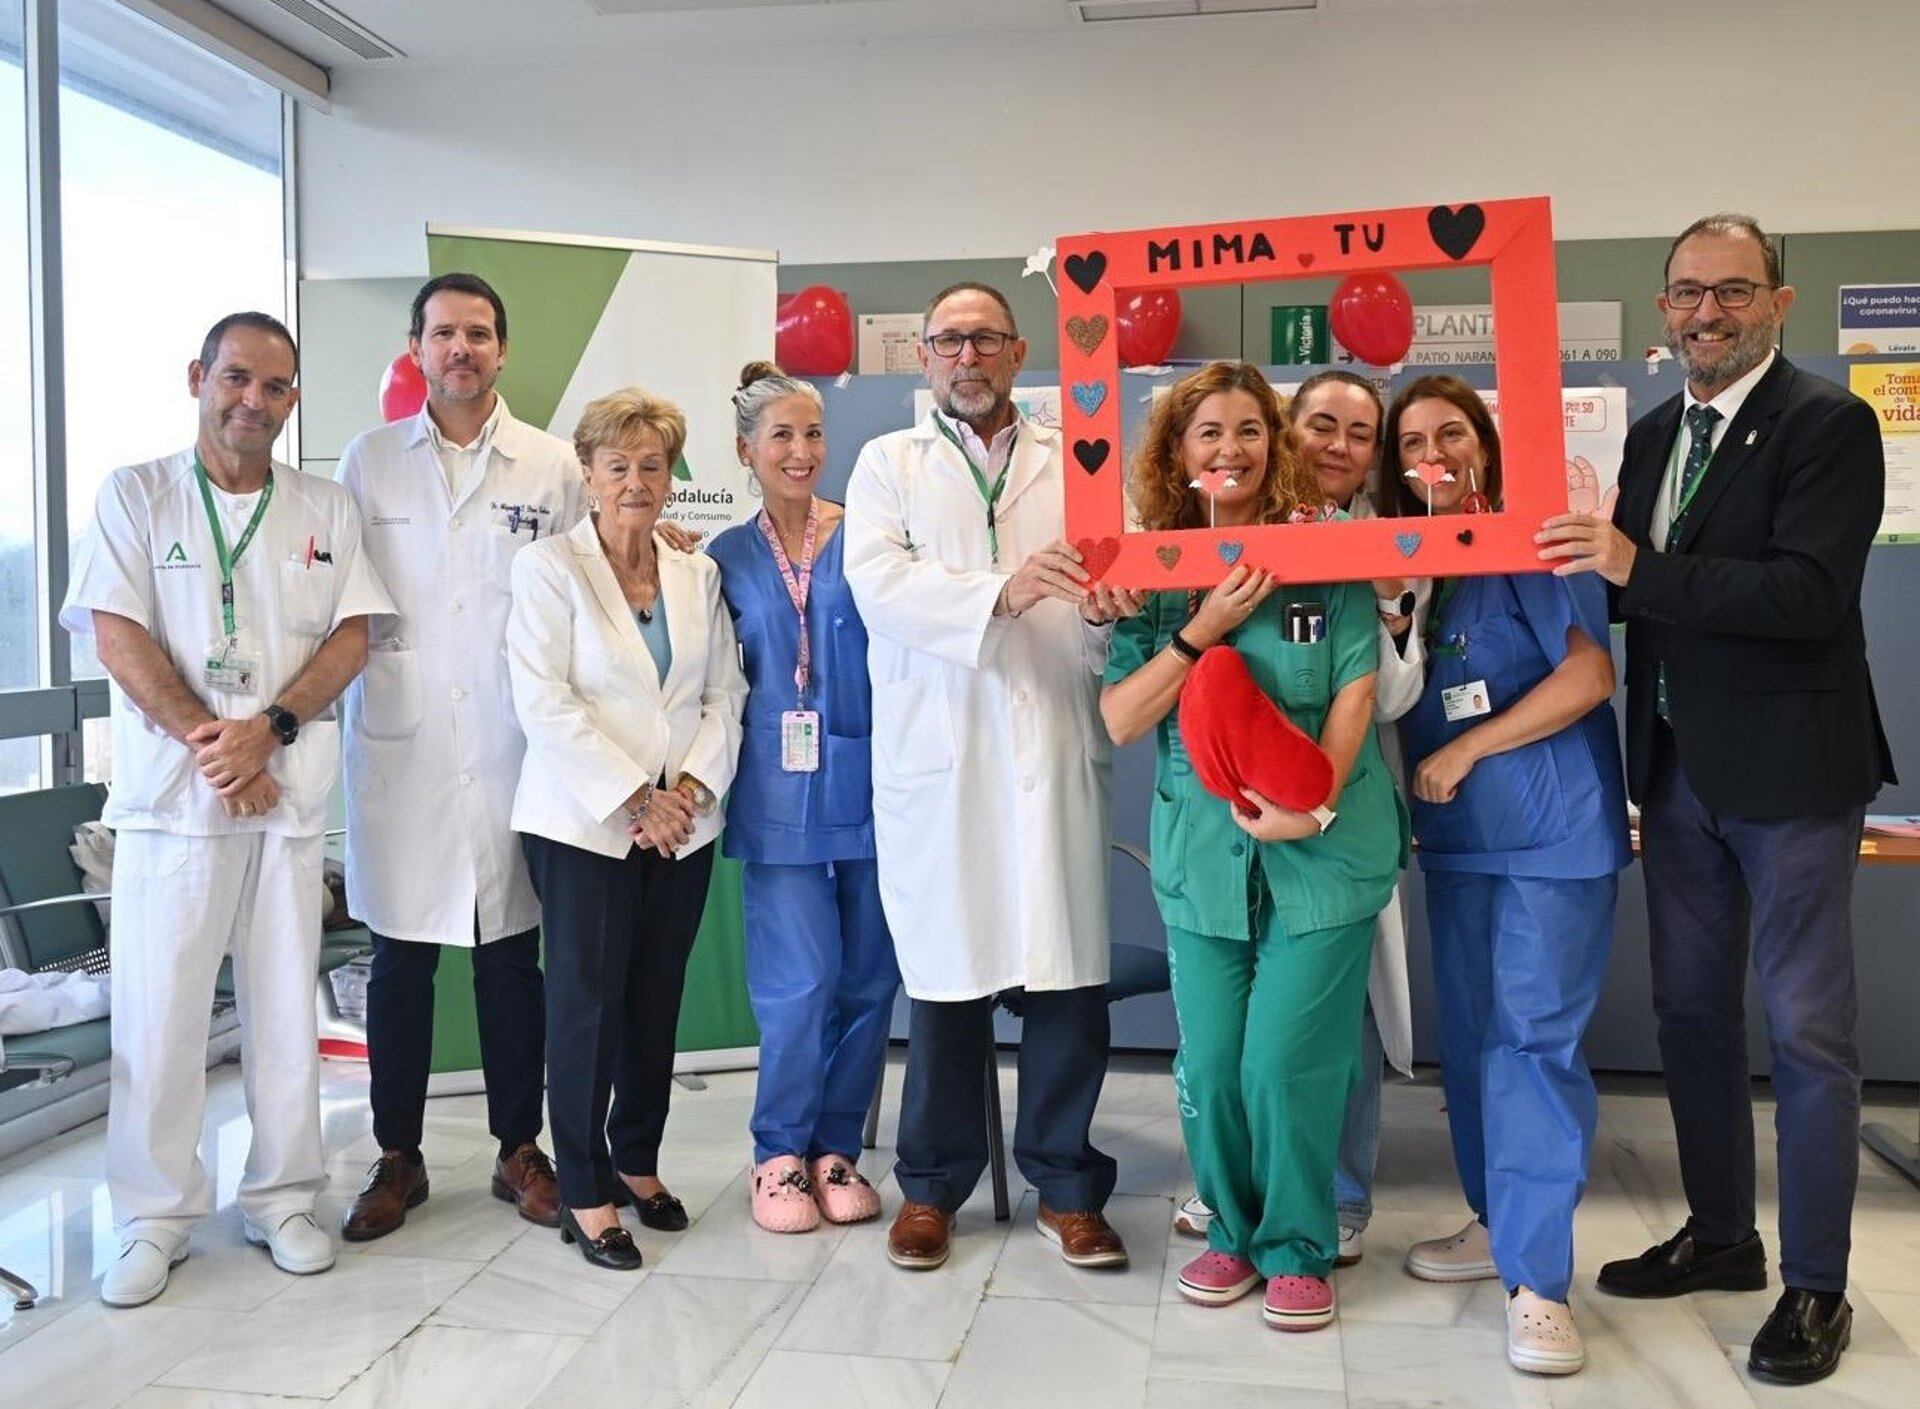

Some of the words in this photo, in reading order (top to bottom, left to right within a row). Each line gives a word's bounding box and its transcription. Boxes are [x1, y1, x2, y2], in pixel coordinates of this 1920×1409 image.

[1148, 233, 1276, 272] MIMA
[1334, 223, 1384, 255] TU
[1870, 295, 1901, 306] puedo
[1860, 305, 1916, 316] coronavirus
[1414, 313, 1495, 336] PLANT
[1299, 315, 1312, 356] Victoria
[1416, 351, 1449, 363] PATIO
[1582, 349, 1591, 360] A
[1595, 348, 1617, 360] 090
[1873, 386, 1886, 396] el
[680, 513, 686, 521] y
[688, 511, 732, 521] Consumo
